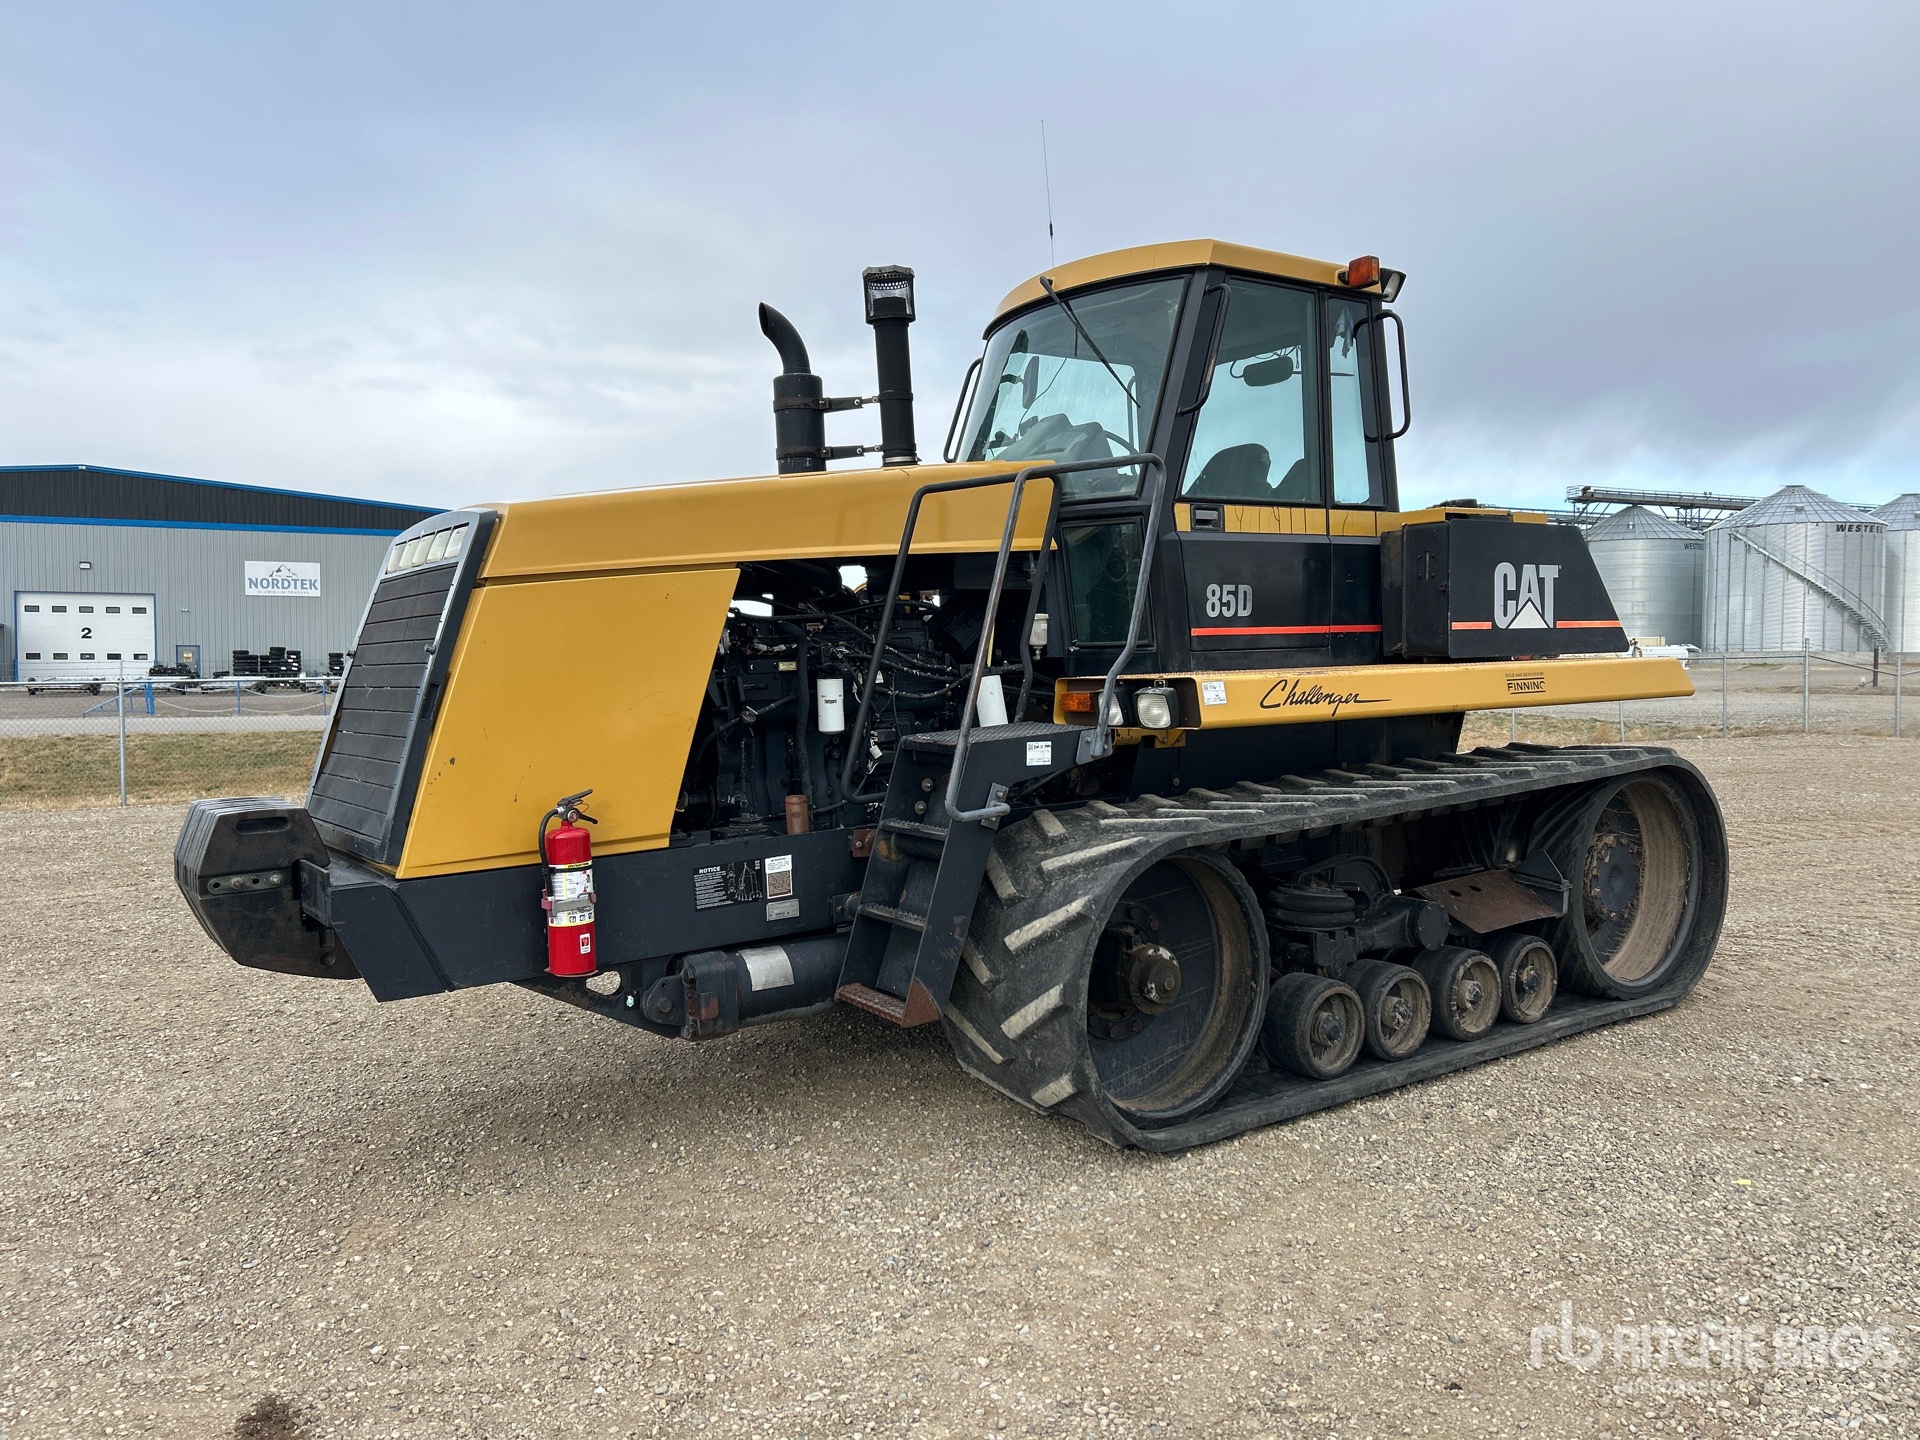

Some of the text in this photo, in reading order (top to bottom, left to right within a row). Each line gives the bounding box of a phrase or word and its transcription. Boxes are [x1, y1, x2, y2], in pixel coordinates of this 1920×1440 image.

[247, 577, 318, 590] NORDTEK
[1494, 562, 1559, 629] CAT
[1206, 583, 1253, 618] 85D
[81, 627, 92, 639] 2
[1260, 679, 1392, 717] Challenger
[699, 866, 721, 874] NOTICE
